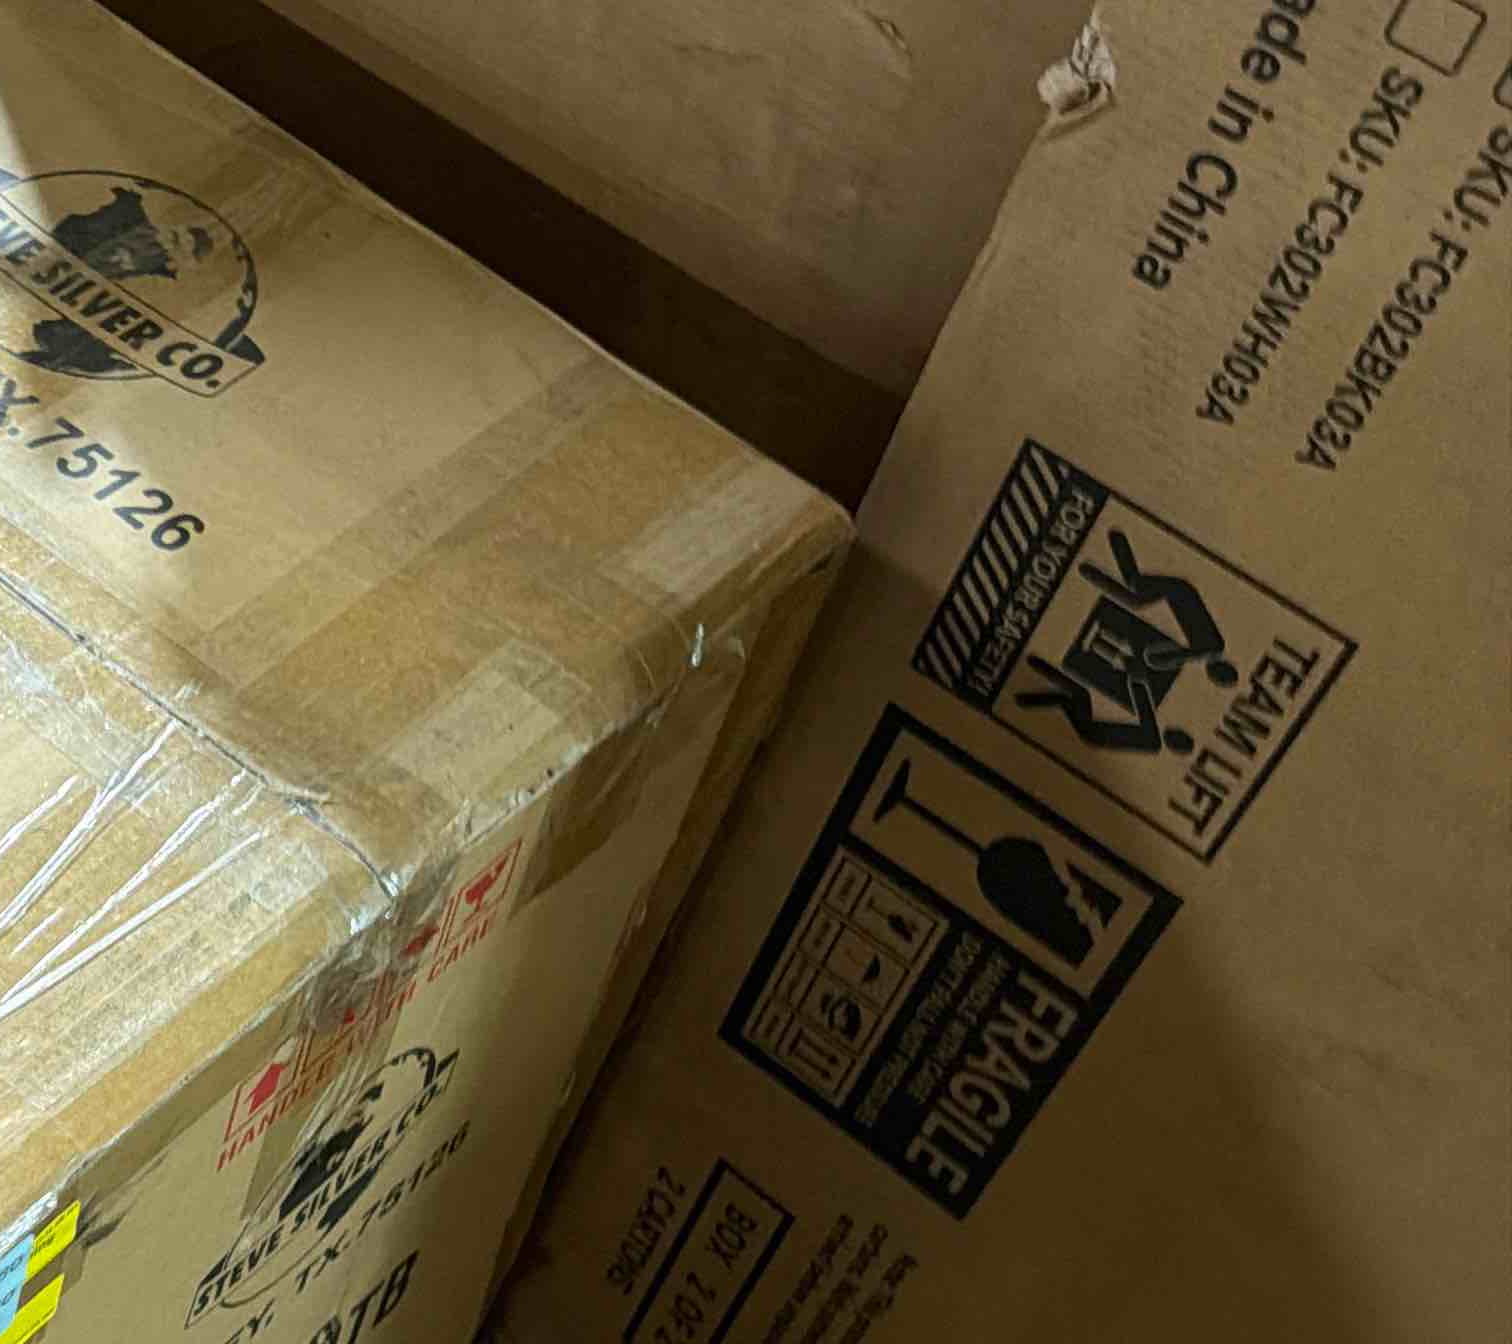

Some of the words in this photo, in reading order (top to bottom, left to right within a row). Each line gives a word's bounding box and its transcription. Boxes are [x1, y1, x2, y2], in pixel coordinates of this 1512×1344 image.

[1206, 84, 1276, 145] in
[1336, 65, 1425, 175] SKU:
[1131, 152, 1240, 291] China
[33, 261, 157, 351] SILVER
[154, 341, 225, 391] CO.
[1196, 170, 1366, 428] FC302WH03A
[1295, 222, 1471, 476] FC302BK03A
[1013, 538, 1069, 606] YOUR
[1048, 487, 1096, 546] FOR
[1213, 634, 1322, 761] TEAM
[1167, 747, 1244, 839] LIFT
[904, 966, 1080, 1195] FRAGILE
[192, 1223, 284, 1317] STEVE
[290, 1127, 392, 1235] SILVER
